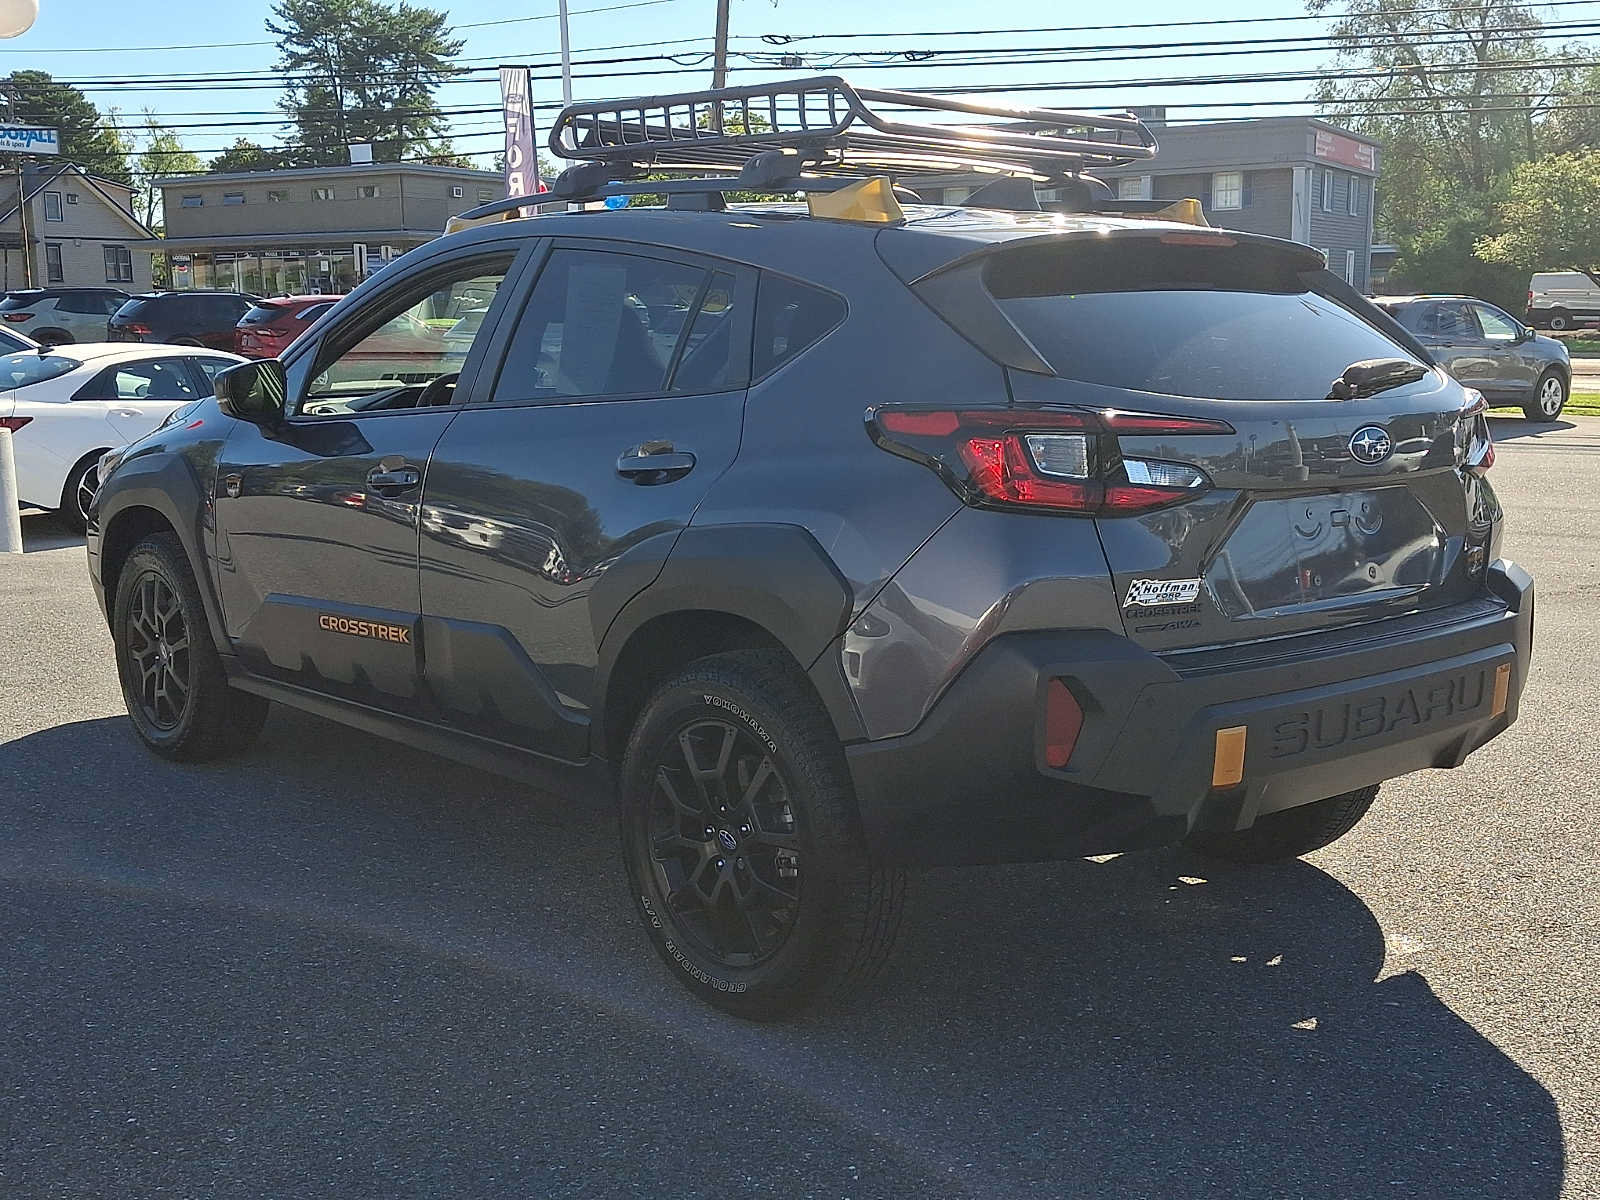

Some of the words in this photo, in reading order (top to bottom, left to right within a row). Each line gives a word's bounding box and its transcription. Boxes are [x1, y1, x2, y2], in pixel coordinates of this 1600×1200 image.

[1143, 582, 1195, 594] Hoffman
[1155, 592, 1182, 600] FORD
[319, 615, 410, 643] CROSSTREK
[703, 694, 777, 753] YOKOHAMA
[1270, 669, 1486, 759] SUBARU
[665, 939, 747, 993] GEOLANDAR
